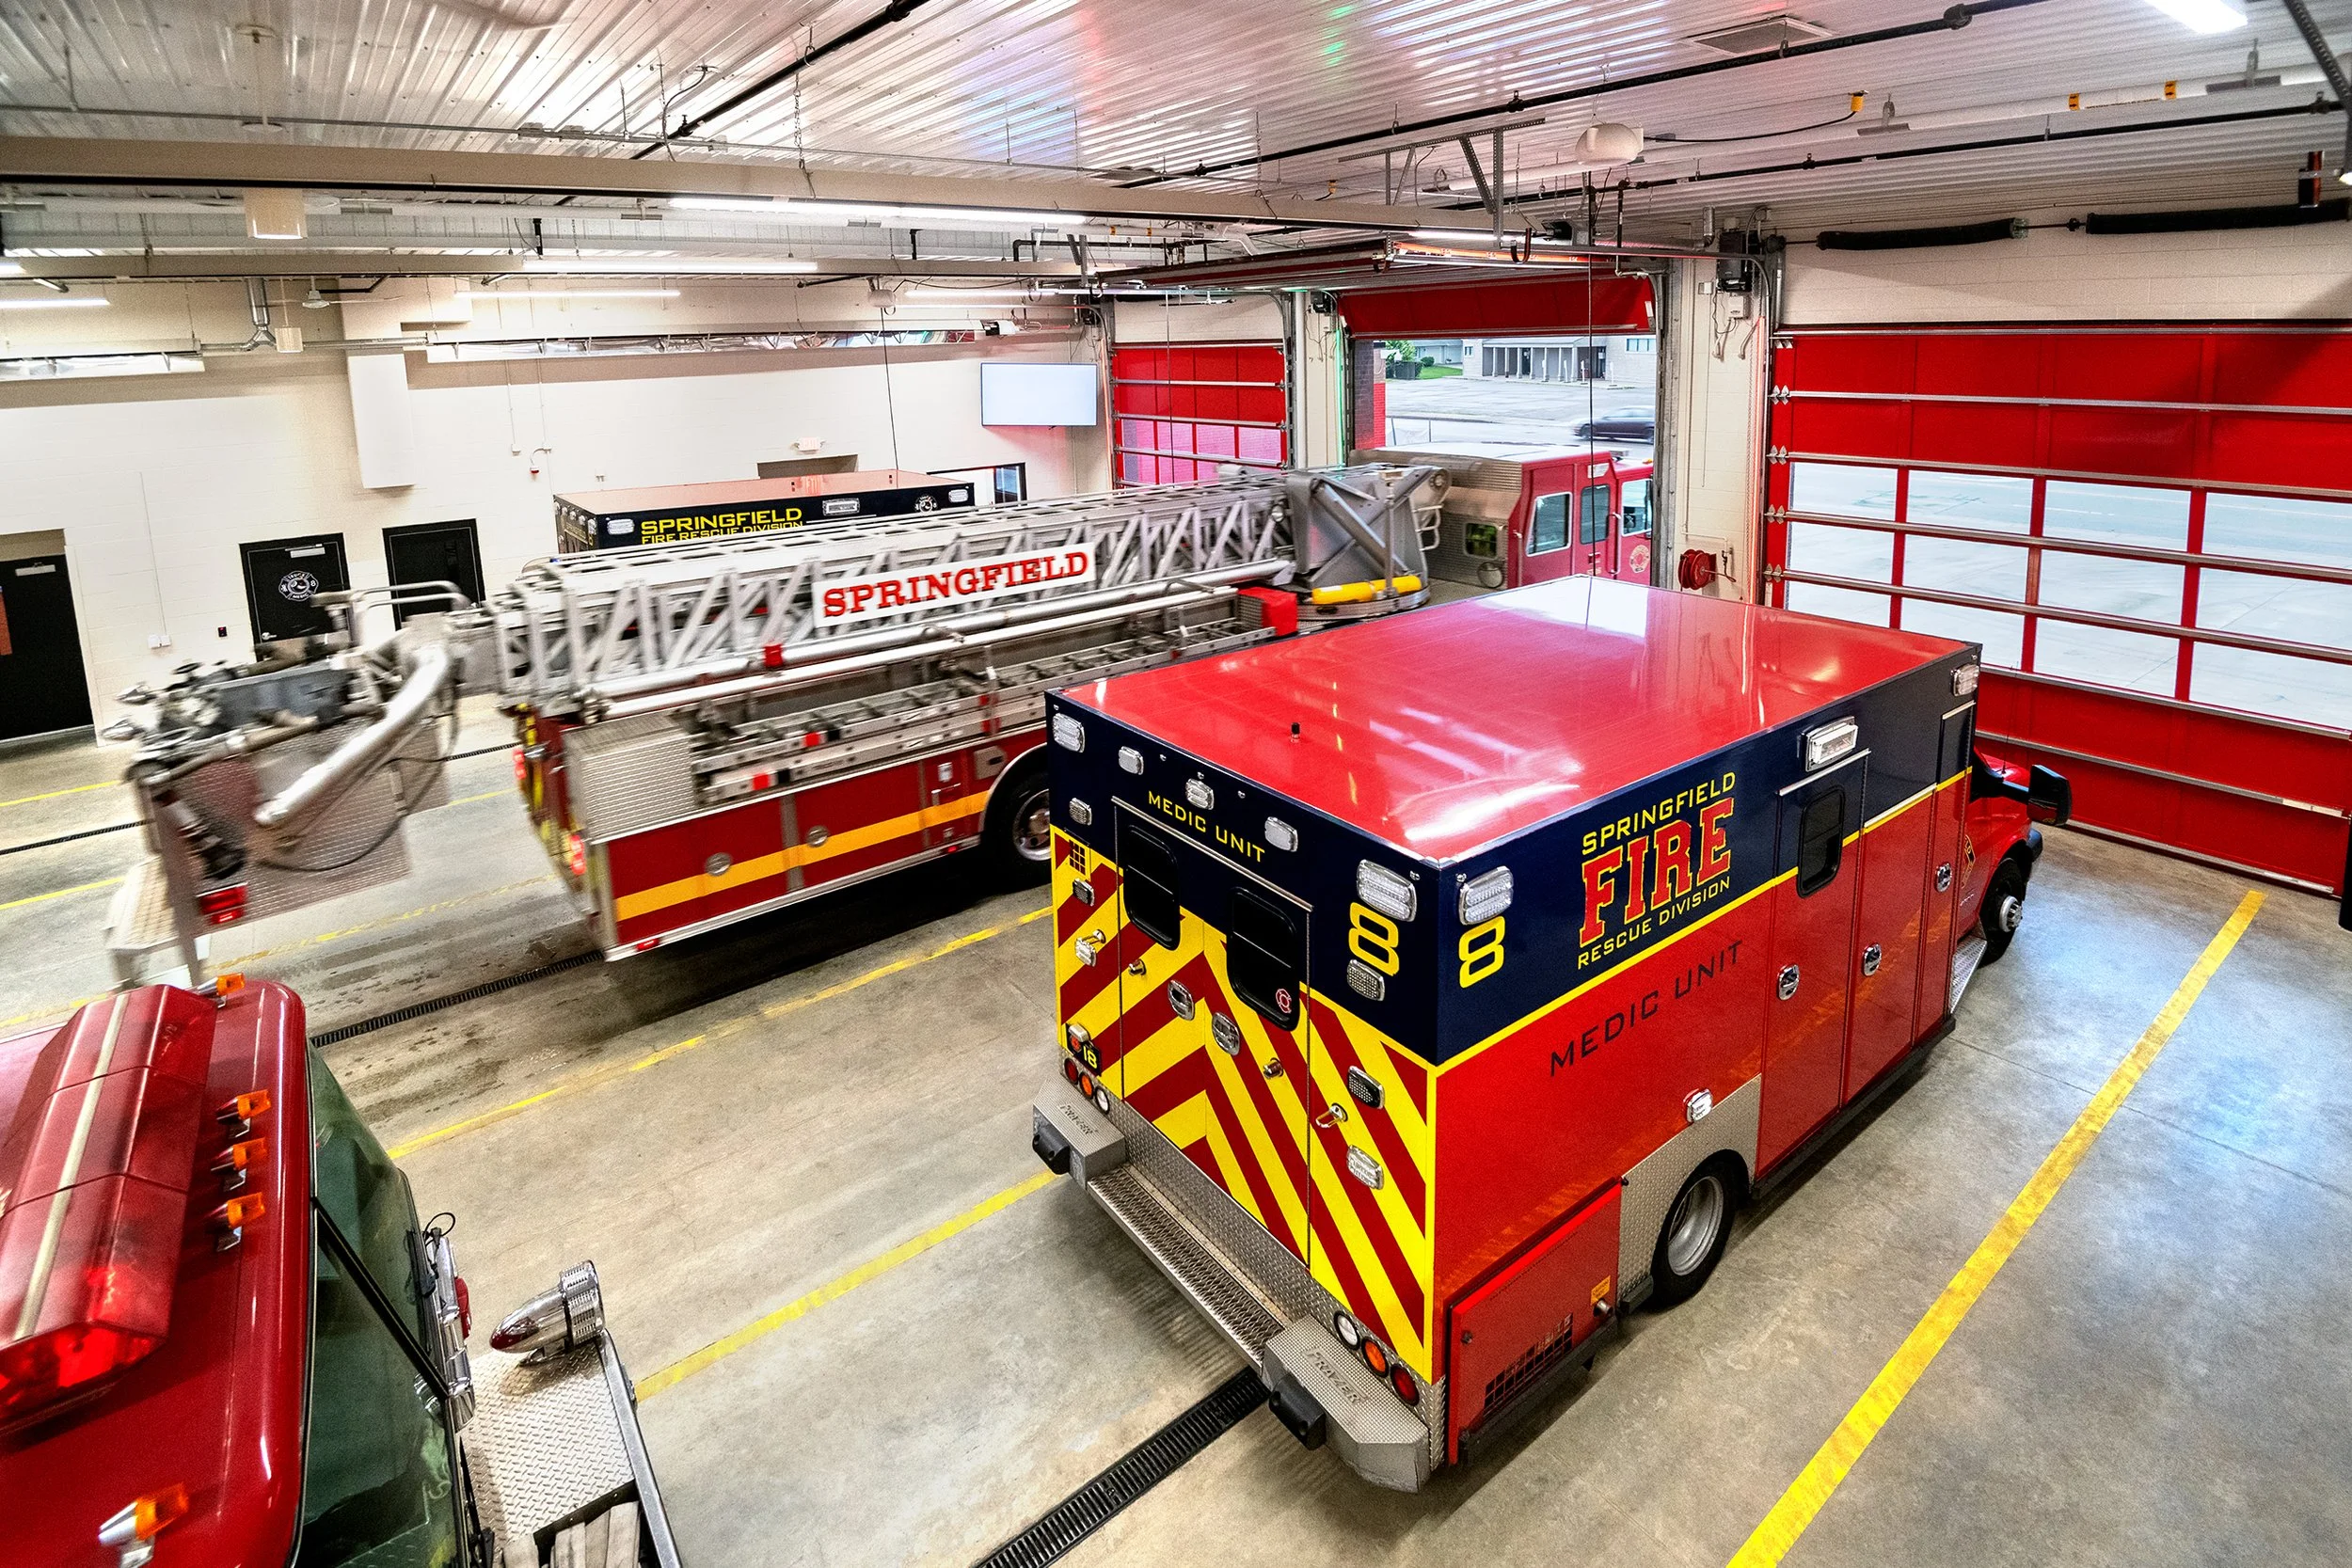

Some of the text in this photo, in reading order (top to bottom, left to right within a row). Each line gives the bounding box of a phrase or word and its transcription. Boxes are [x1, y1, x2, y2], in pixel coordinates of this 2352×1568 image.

[641, 508, 803, 534] SPRINGFIELD
[642, 521, 803, 545] FIRE RESCUE DIVISION
[822, 551, 1089, 617] SPRINGFIELD
[1149, 790, 1265, 863] MEDIC UNIT
[1581, 771, 1736, 856] SPRINGFIELD
[1580, 796, 1734, 948] FIRE
[1348, 902, 1400, 976] 8
[1458, 915, 1506, 989] 8
[1578, 876, 1730, 970] RESCUE DIVISION
[1549, 940, 1743, 1077] MEDIC UNIT
[1305, 1349, 1366, 1404] FRAZER
